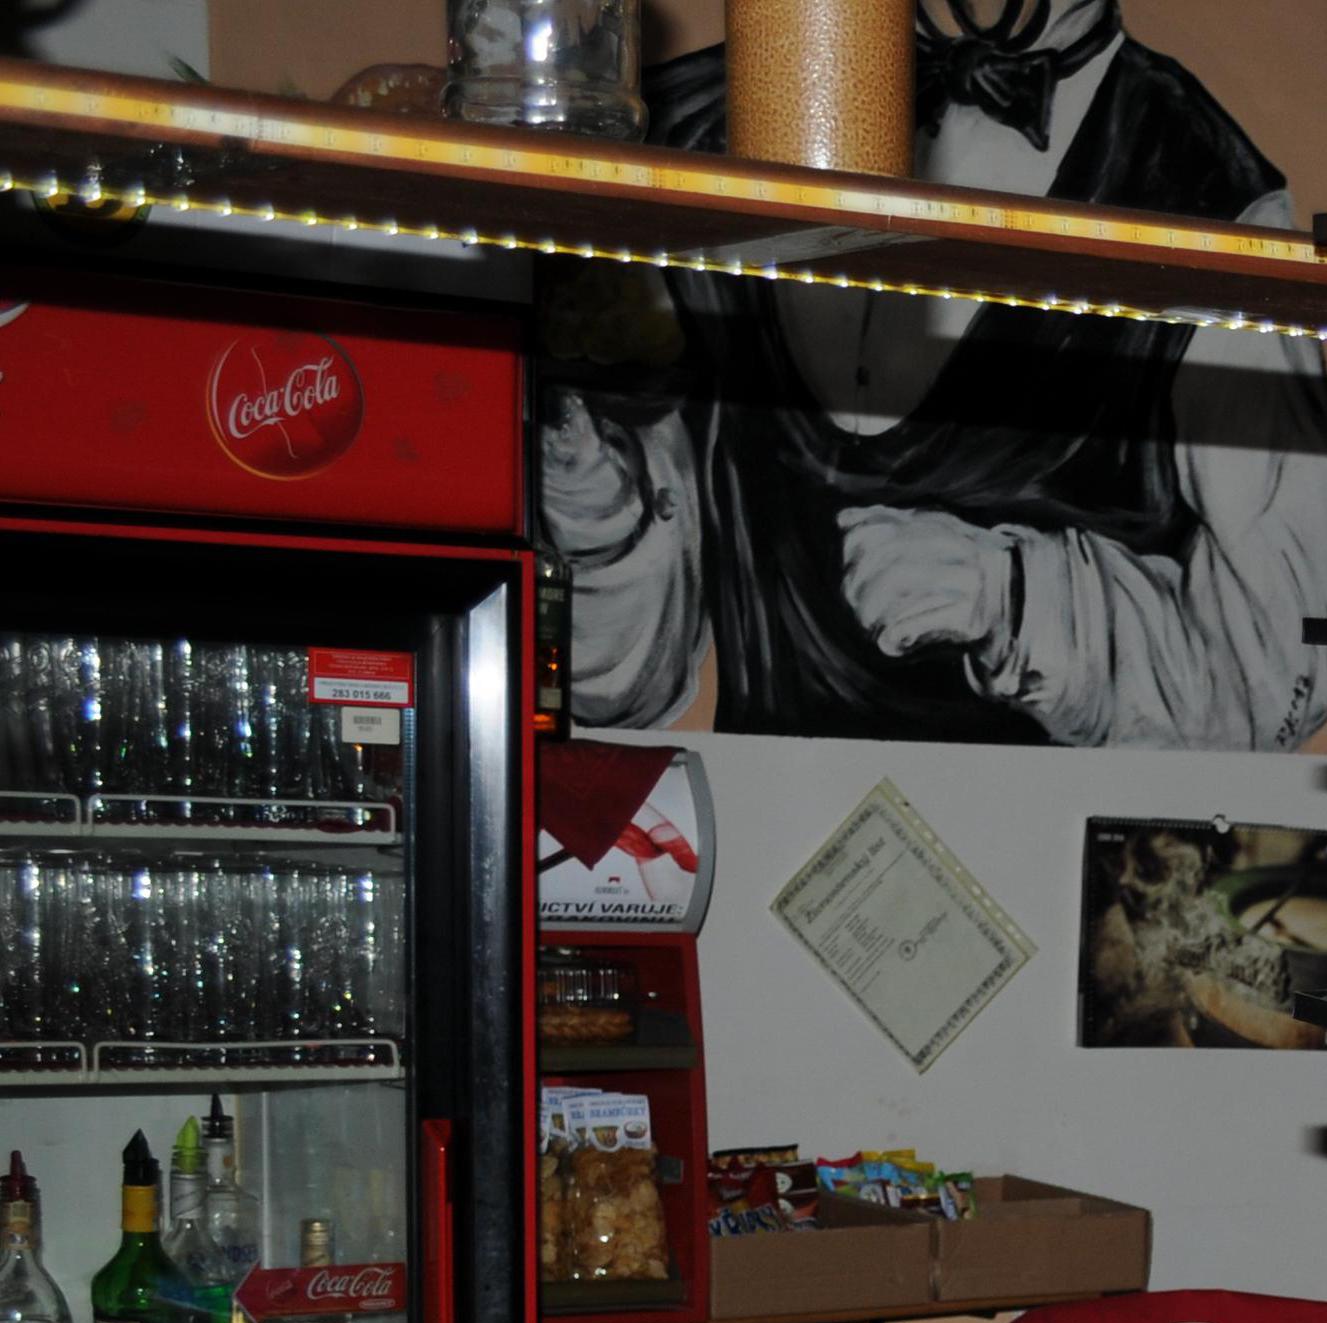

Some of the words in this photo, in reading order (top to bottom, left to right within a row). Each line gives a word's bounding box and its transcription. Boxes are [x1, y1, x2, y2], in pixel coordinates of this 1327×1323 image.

[228, 357, 340, 439] Coca-Cola
[331, 688, 350, 699] 283
[353, 690, 371, 700] 015
[601, 902, 685, 915] VARUJE:
[307, 1266, 396, 1300] Coca-Cola
